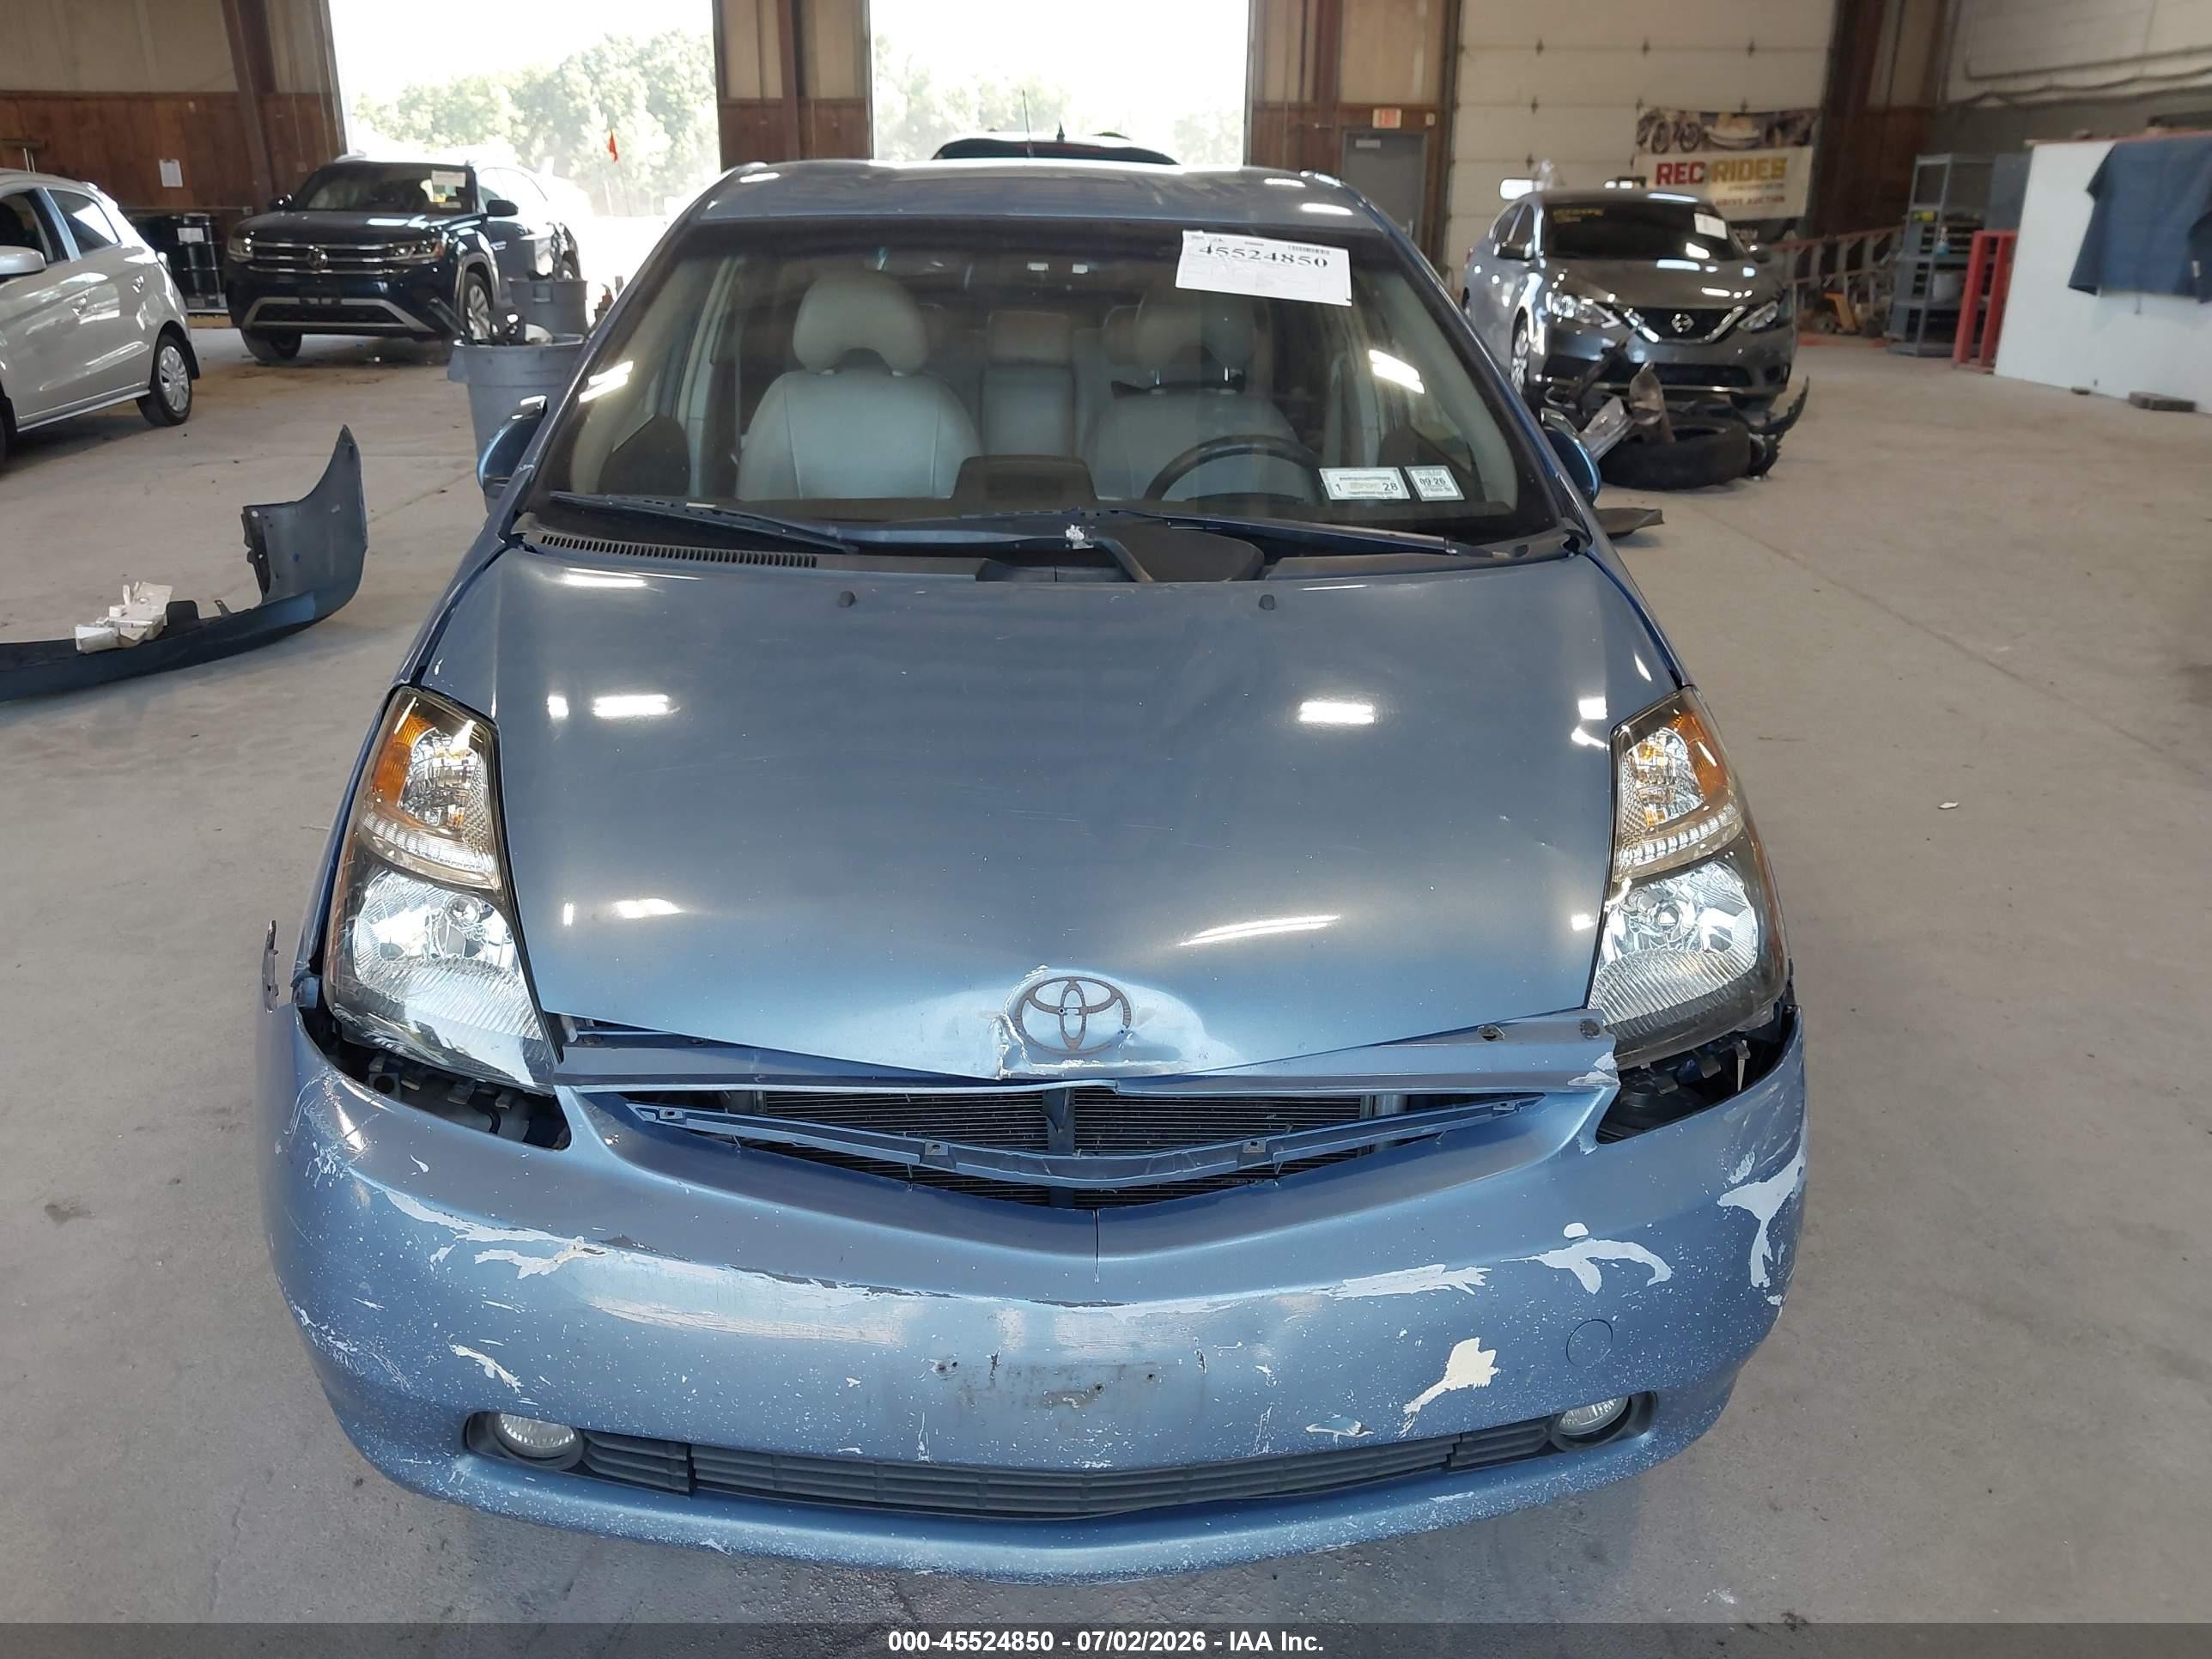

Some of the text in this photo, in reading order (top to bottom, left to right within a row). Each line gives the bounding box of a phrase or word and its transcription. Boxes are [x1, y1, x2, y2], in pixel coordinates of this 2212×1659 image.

[1655, 157, 1788, 185] REC RIDES
[1198, 244, 1328, 268] 45524850
